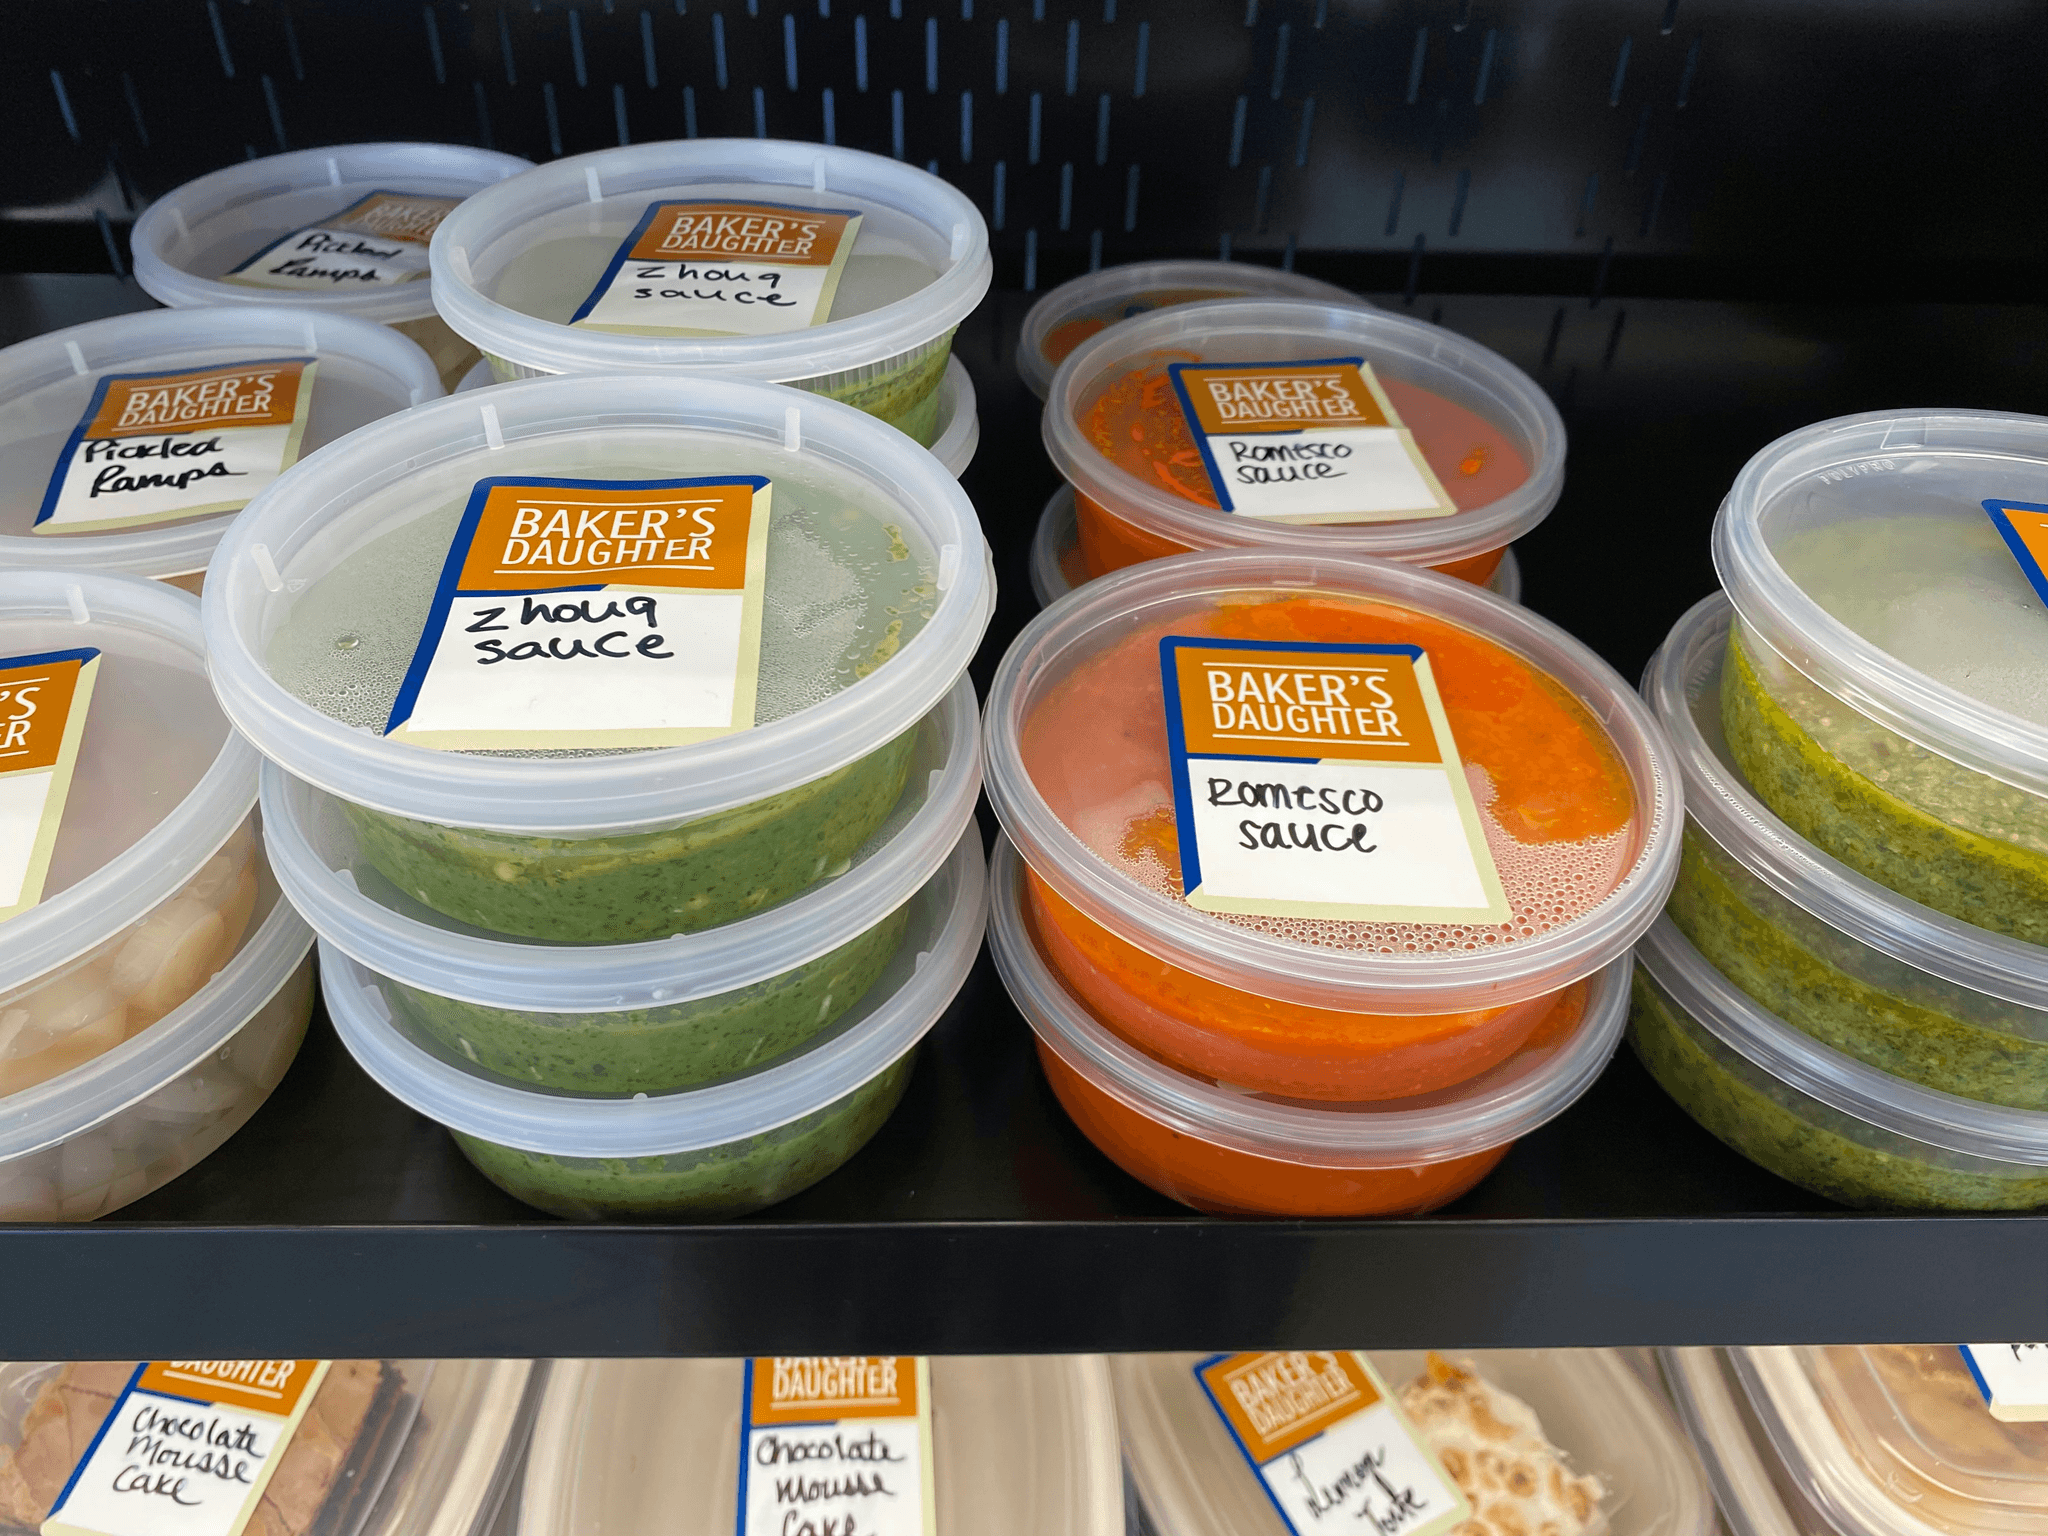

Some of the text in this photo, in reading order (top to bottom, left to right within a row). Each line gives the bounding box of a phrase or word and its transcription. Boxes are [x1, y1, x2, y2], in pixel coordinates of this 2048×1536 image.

[661, 234, 813, 255] DAUGHTER
[670, 215, 820, 242] BAKER'S
[634, 287, 797, 306] sauce
[126, 374, 275, 412] BAKER'S
[1208, 379, 1350, 402] BAKER'S
[118, 394, 272, 427] DAUGHTER
[1216, 399, 1360, 419] DAUGHTER
[85, 437, 224, 463] Pickled
[90, 461, 249, 498] Ramps
[1237, 462, 1347, 484] sauce
[510, 507, 717, 540] BAKER'S
[501, 537, 712, 566] DAUGHTER
[474, 630, 675, 665] sauce
[1208, 669, 1393, 709] BAKER'S
[1212, 702, 1403, 737] DAUGHTER
[1239, 819, 1378, 853] sauce
[772, 1366, 898, 1400] DAUGHTER
[133, 1406, 264, 1458] Chocolate
[757, 1431, 906, 1466] Chocolate
[126, 1435, 251, 1483] Mousse
[113, 1465, 203, 1505] Cake
